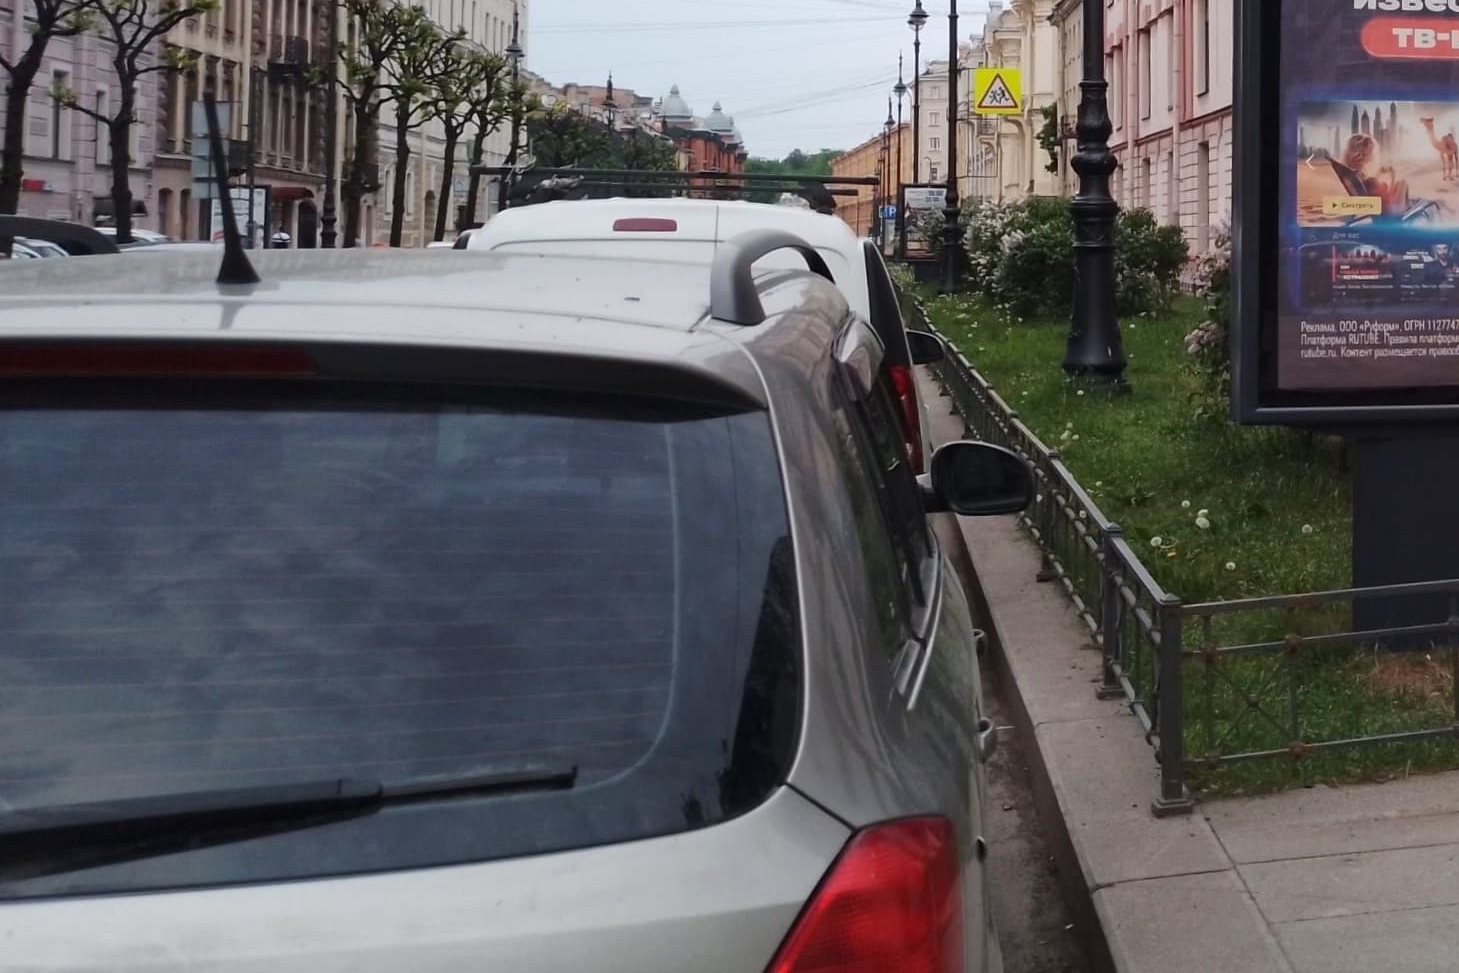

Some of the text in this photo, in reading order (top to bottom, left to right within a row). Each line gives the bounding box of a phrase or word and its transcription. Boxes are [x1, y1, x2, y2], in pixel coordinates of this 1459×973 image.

[1340, 320, 1358, 332] ООО
[1404, 319, 1426, 331] ОГРН
[1301, 333, 1347, 346] Платформа
[1383, 331, 1417, 346] Правила
